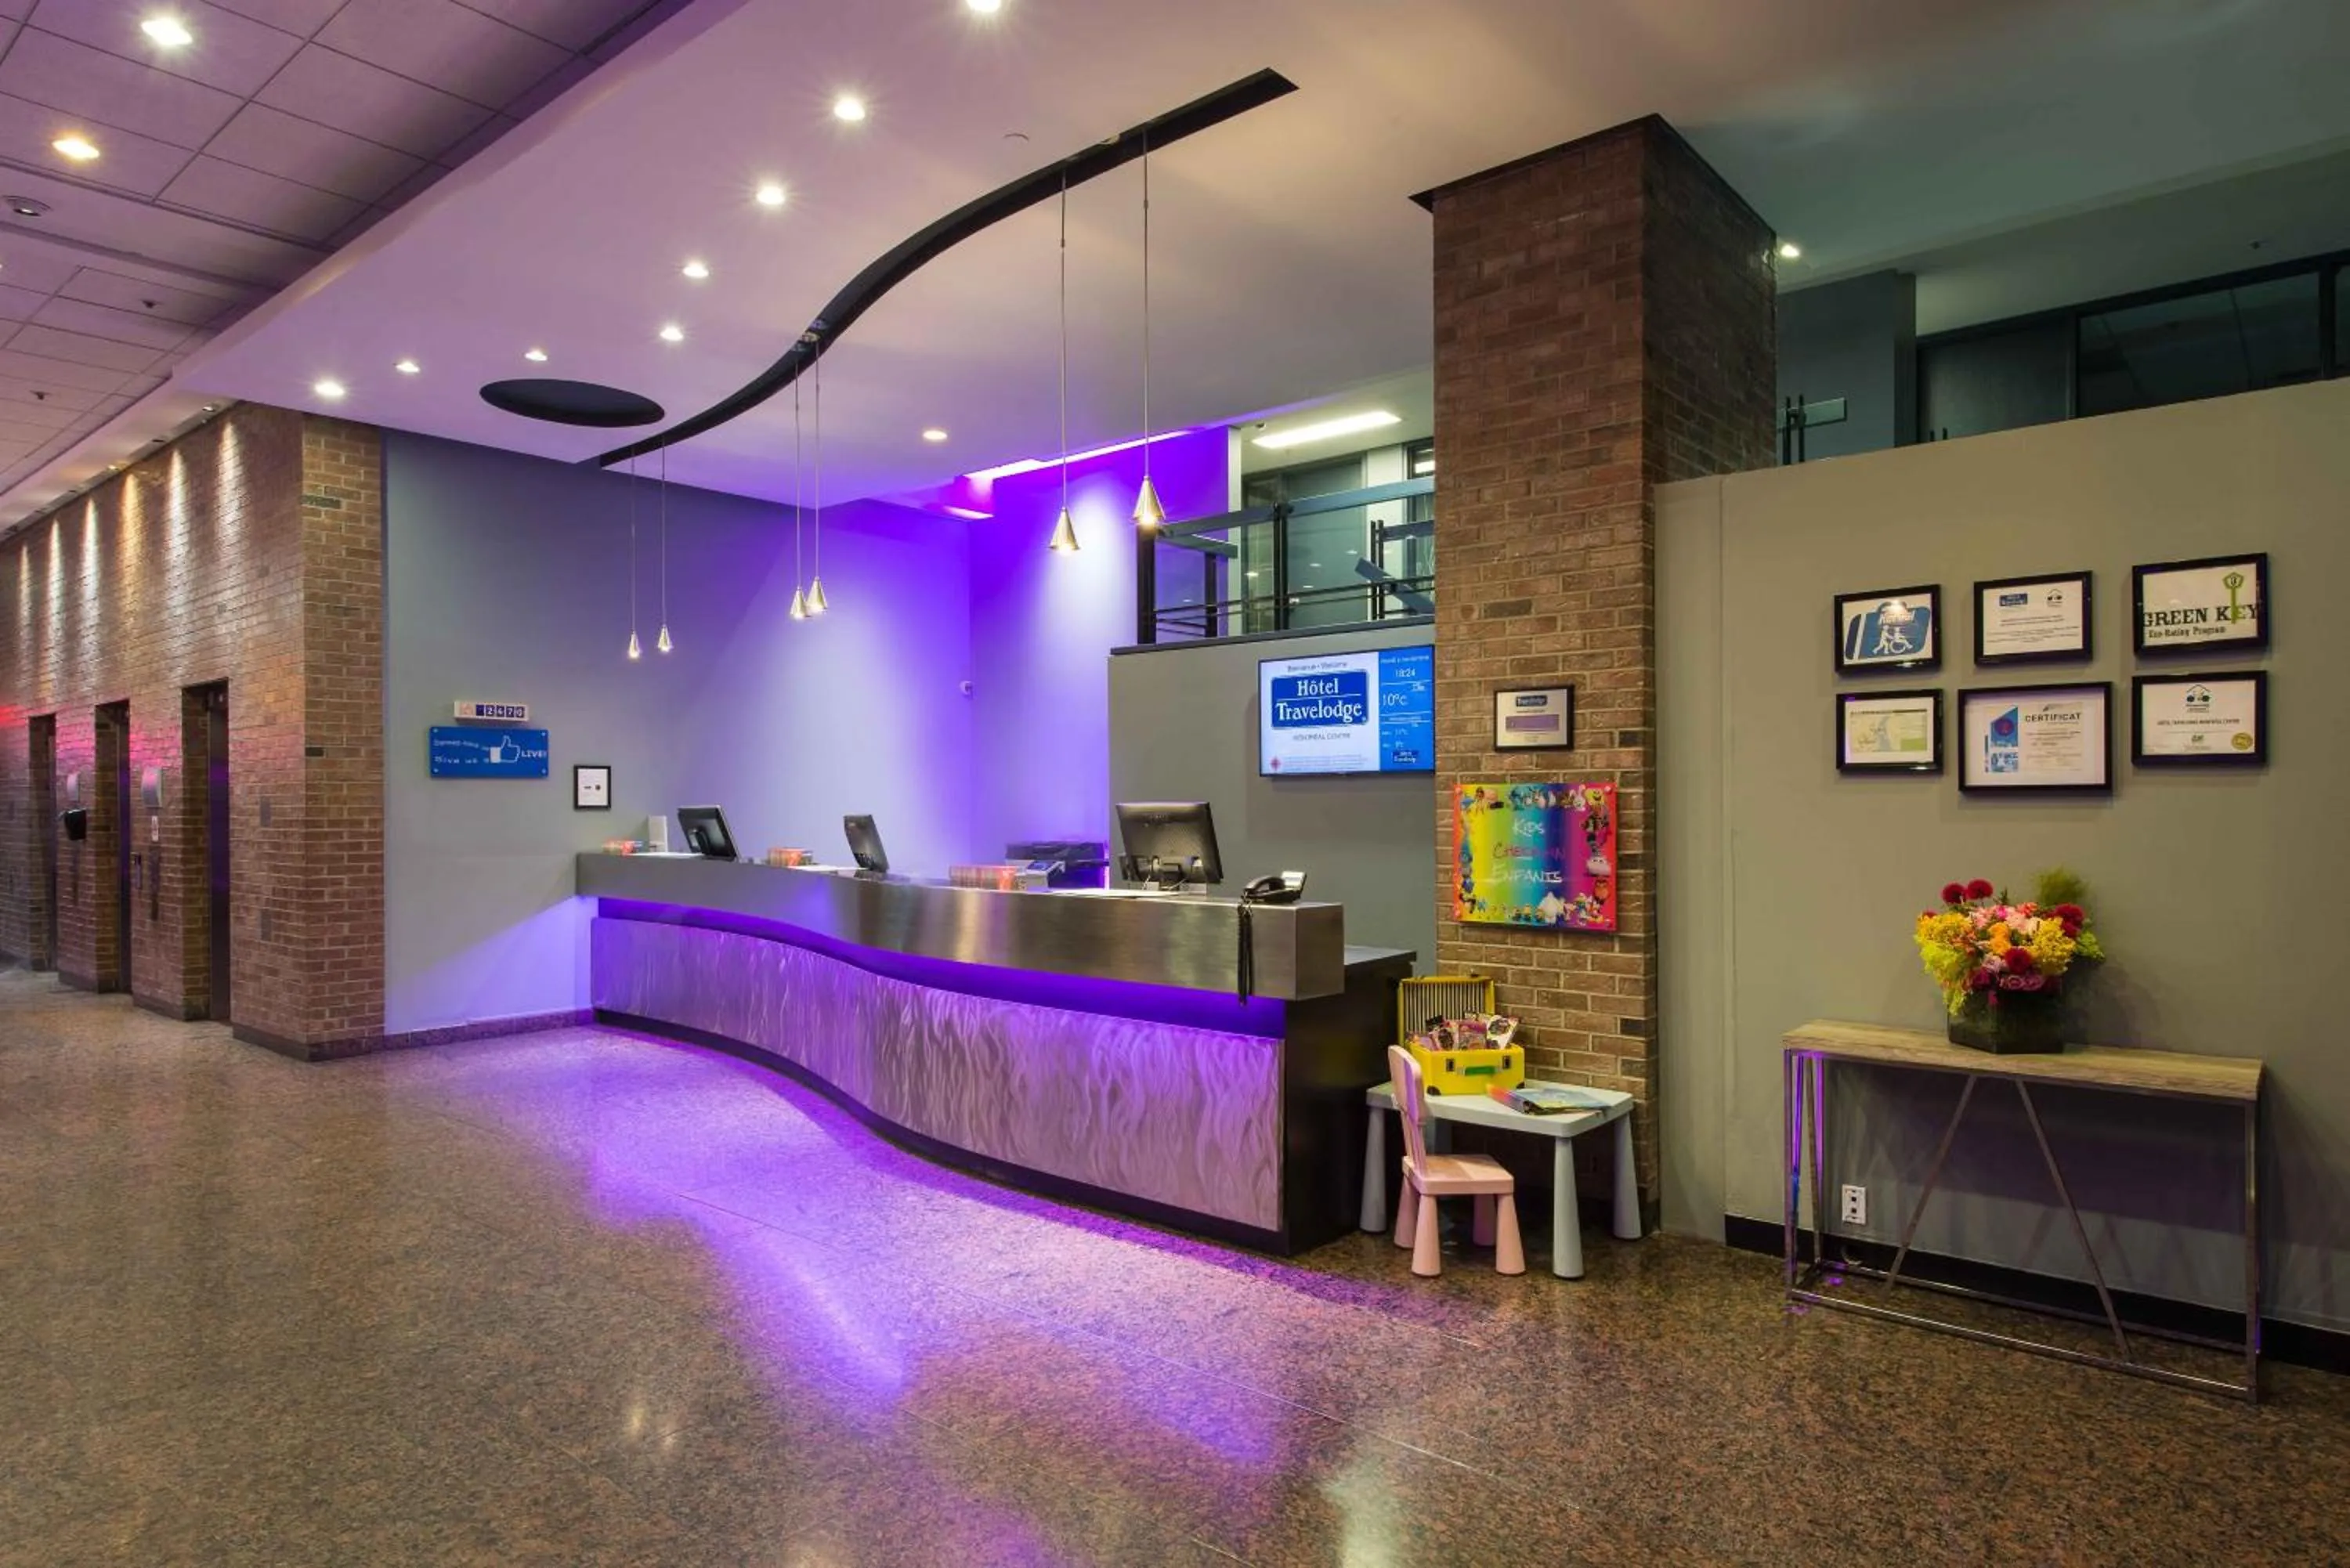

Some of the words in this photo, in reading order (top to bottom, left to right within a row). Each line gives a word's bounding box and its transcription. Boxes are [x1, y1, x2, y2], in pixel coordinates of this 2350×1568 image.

[2143, 607, 2208, 627] GREEN
[1297, 677, 1339, 696] Hôtel
[1275, 699, 1362, 723] Travelodge
[2025, 712, 2081, 722] CERTIFICAT
